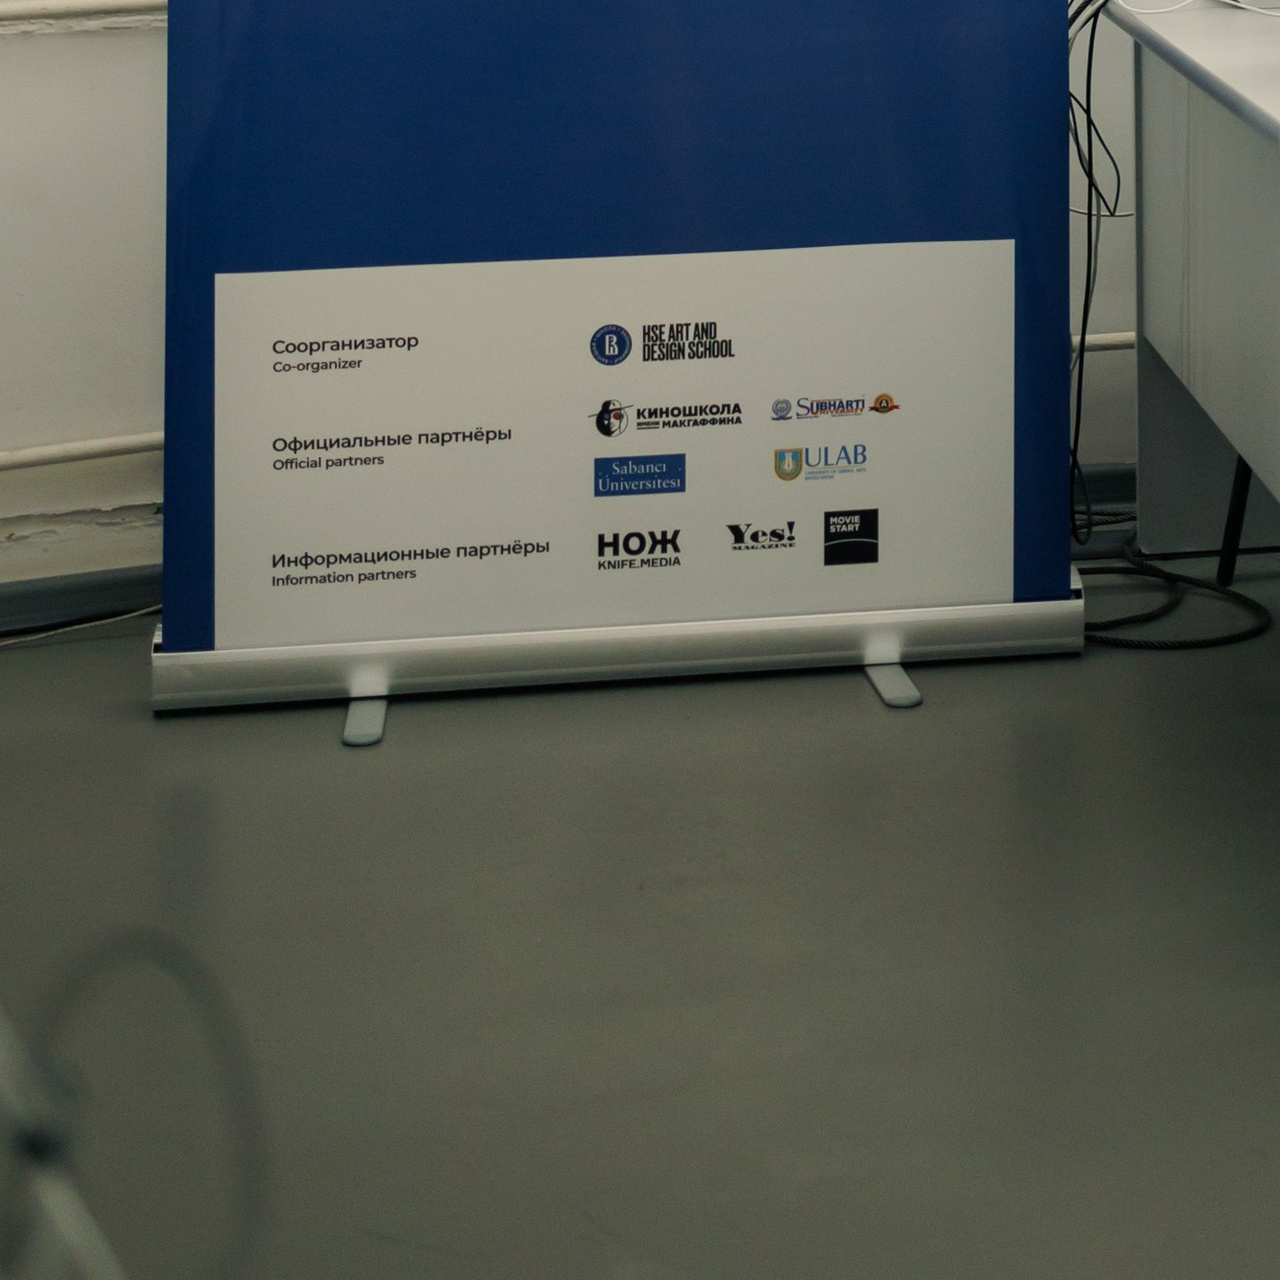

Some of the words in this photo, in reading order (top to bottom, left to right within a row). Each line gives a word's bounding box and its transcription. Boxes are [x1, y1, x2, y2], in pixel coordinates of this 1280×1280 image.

[642, 325, 666, 342] HSE
[668, 323, 691, 341] ART
[694, 322, 717, 340] AND
[272, 335, 419, 356] Соорганизатор
[642, 342, 685, 362] DESIGN
[688, 339, 735, 359] SCHOOL
[272, 357, 363, 374] Co-organizer
[636, 403, 742, 419] КИНОШКОЛА
[662, 416, 742, 429] МАКГАФФИНА
[272, 432, 413, 454] Официальные
[417, 426, 512, 446] партнёры
[272, 457, 322, 471] Official
[325, 454, 385, 470] partners
[805, 444, 867, 468] ULAB
[829, 515, 861, 524] MOVIE
[829, 523, 861, 533] START
[726, 520, 796, 545] Yes!
[598, 529, 681, 558] НОЖ
[731, 542, 796, 551] MAGAZINE
[271, 544, 451, 570] Информационные
[456, 540, 551, 559] партнёры
[598, 556, 681, 571] KNIFE.MEDIA
[271, 571, 354, 587] Information
[357, 568, 417, 584] partners
